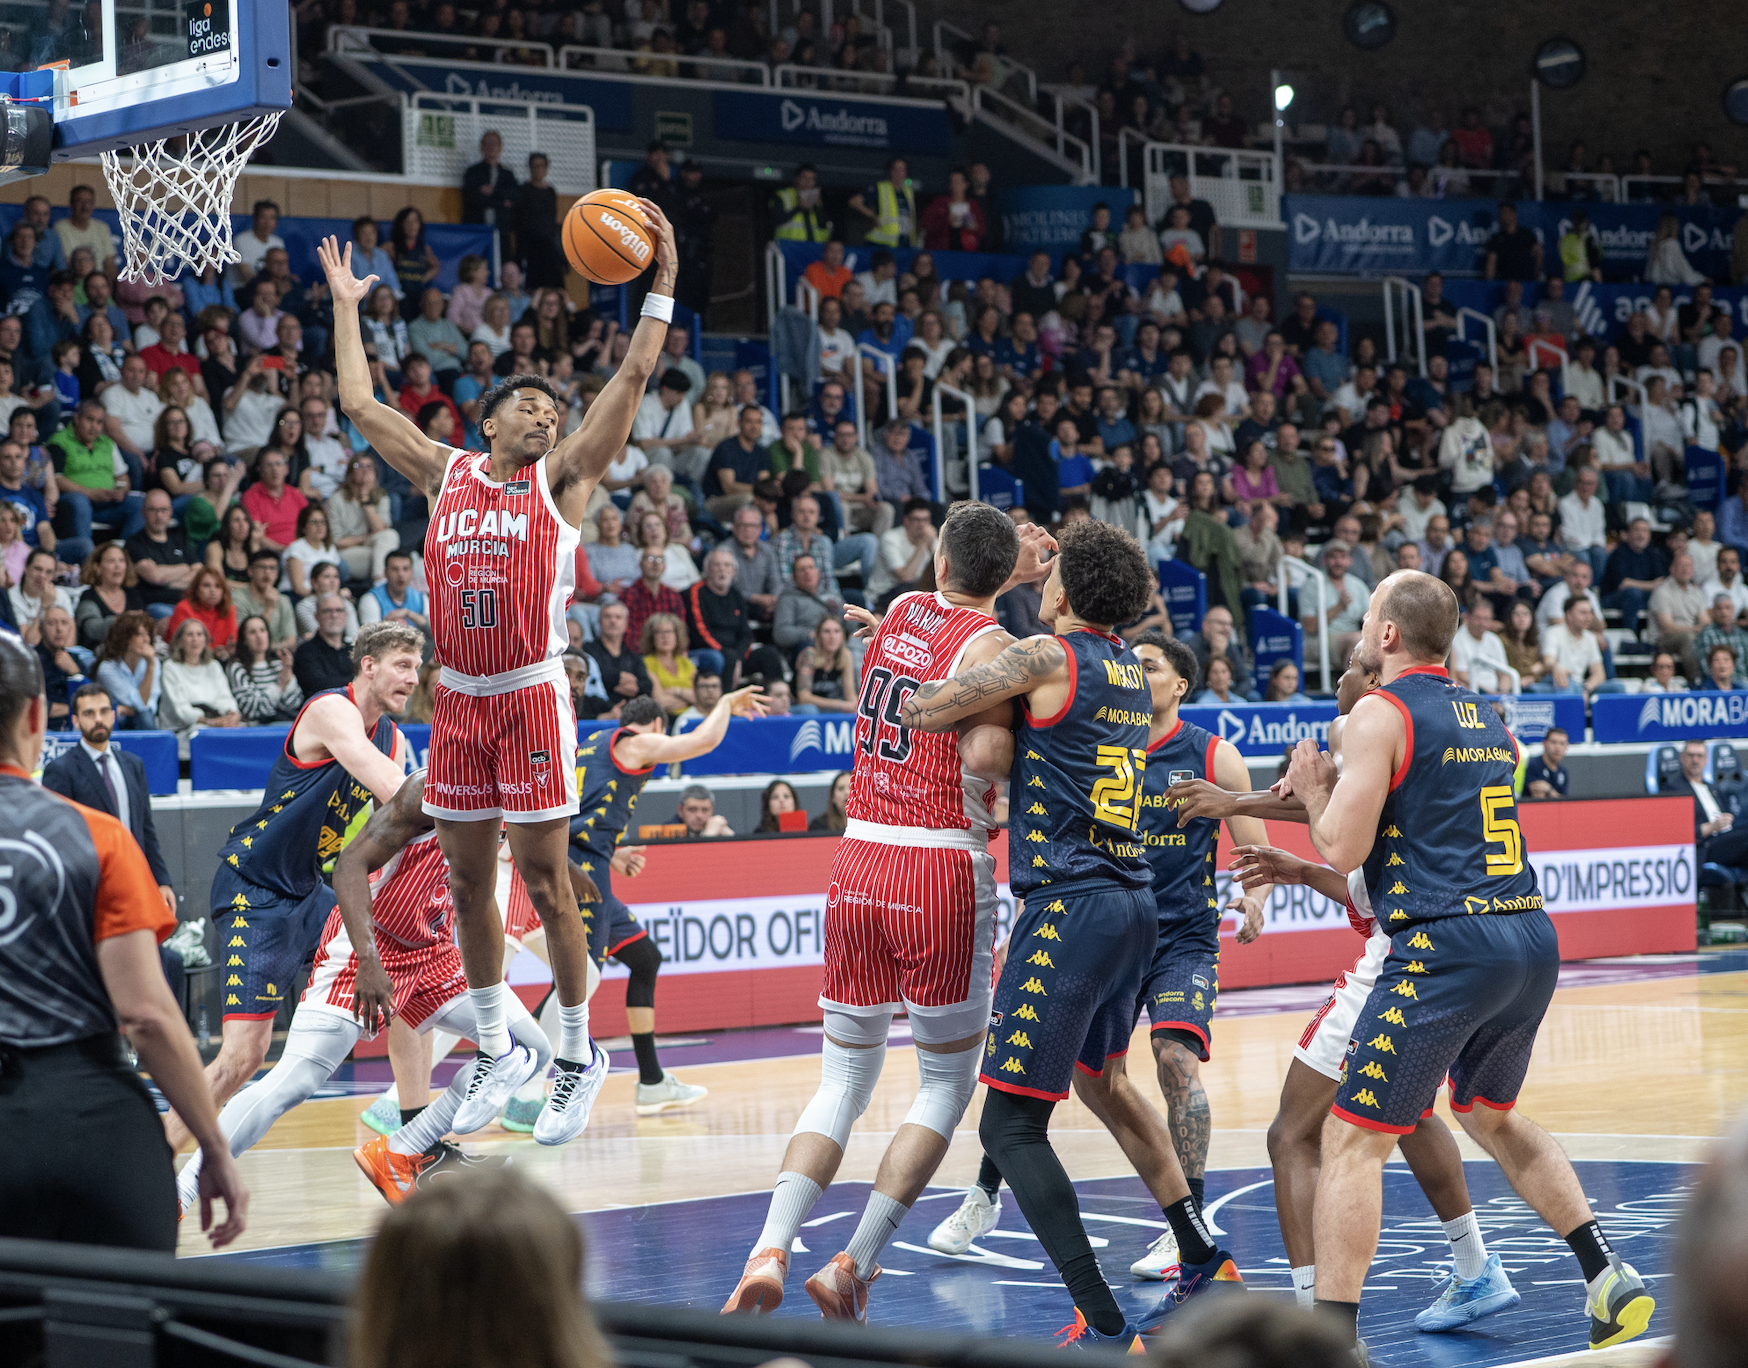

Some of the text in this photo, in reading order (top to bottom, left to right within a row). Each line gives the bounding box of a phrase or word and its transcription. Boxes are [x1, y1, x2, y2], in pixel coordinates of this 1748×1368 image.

[189, 17, 211, 38] liga
[805, 106, 888, 136] Andorra
[599, 211, 650, 263] Wilson
[1323, 217, 1415, 243] Andorra
[437, 508, 528, 542] UCAM
[446, 539, 510, 559] MURCIA
[460, 589, 497, 629] 50
[858, 665, 921, 764] 99
[1451, 701, 1486, 729] LUZ
[1480, 785, 1524, 876] 5
[876, 900, 886, 908] DE
[888, 902, 923, 914] MURCIA
[768, 910, 827, 957] OFI
